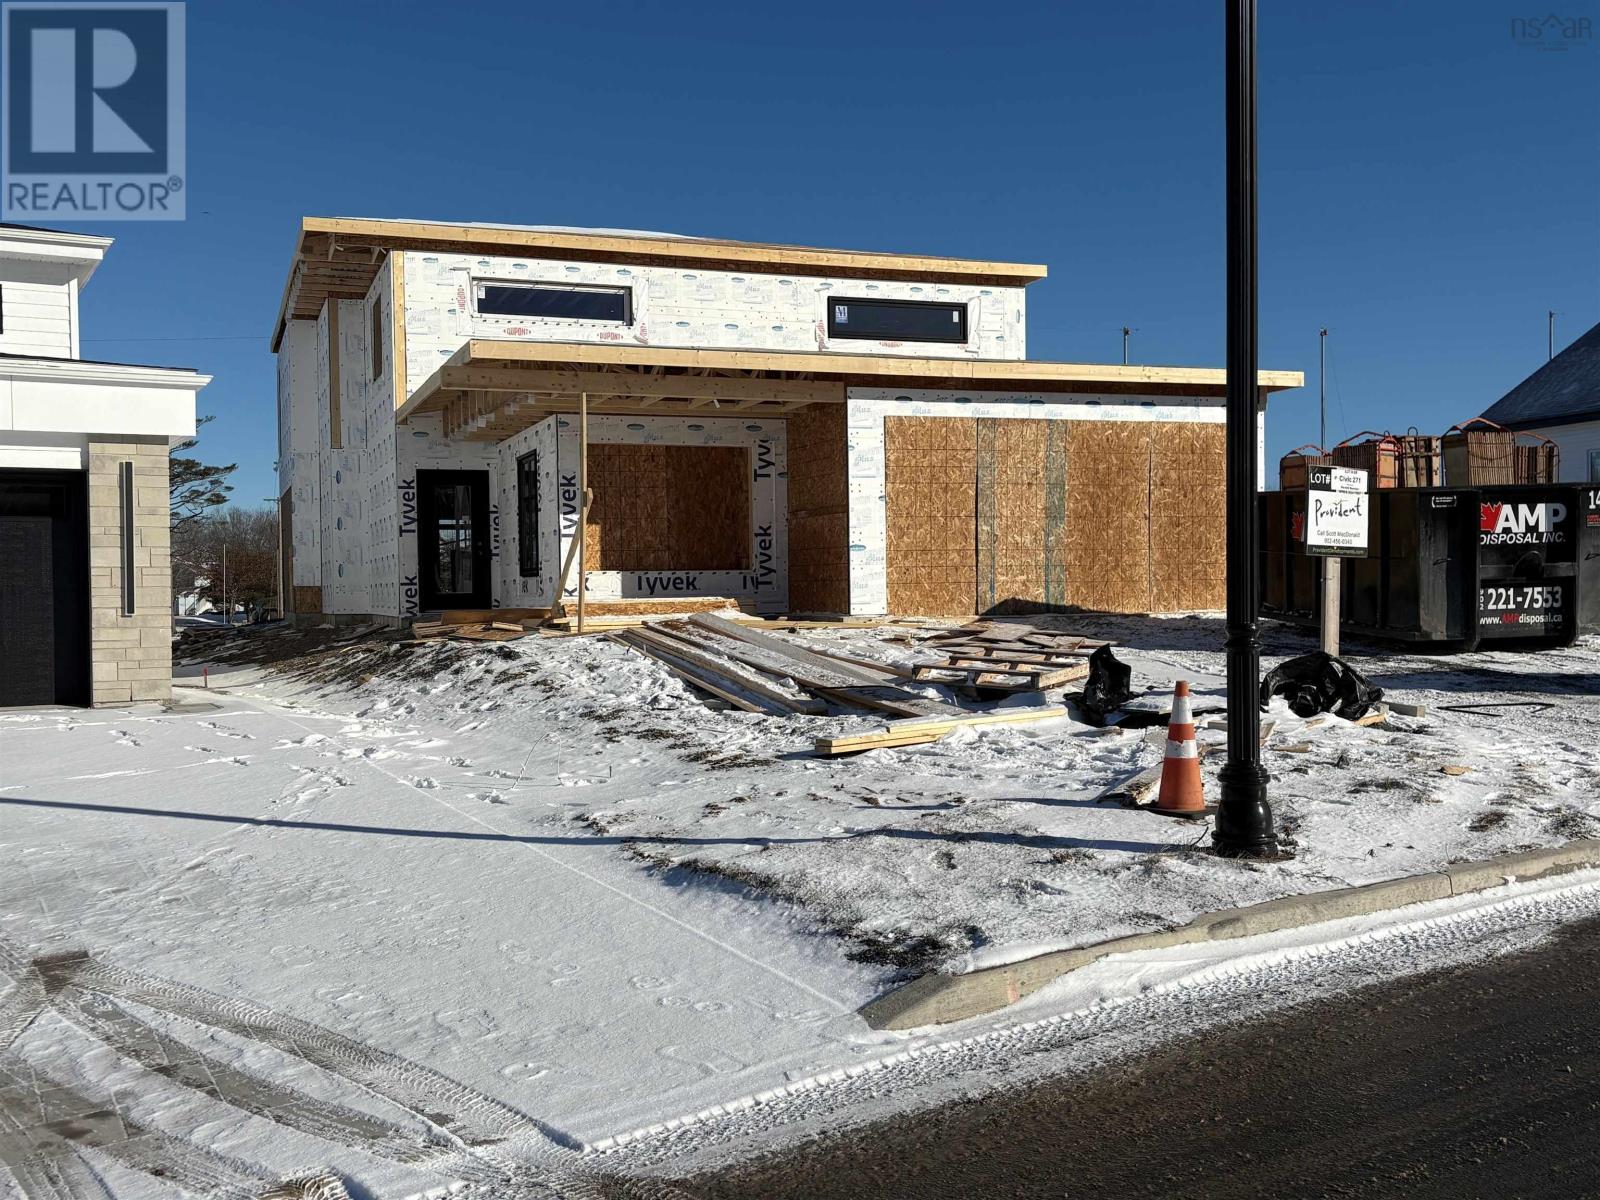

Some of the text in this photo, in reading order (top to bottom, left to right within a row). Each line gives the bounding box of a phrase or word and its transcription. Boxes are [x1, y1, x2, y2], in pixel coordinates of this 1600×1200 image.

[1310, 473, 1331, 484] LOT#
[1315, 497, 1362, 526] Provident
[1495, 504, 1567, 533] AMP
[1480, 533, 1539, 545] DISPOSAL
[754, 525, 776, 590] Tyvek
[1488, 586, 1562, 610] 221-7553
